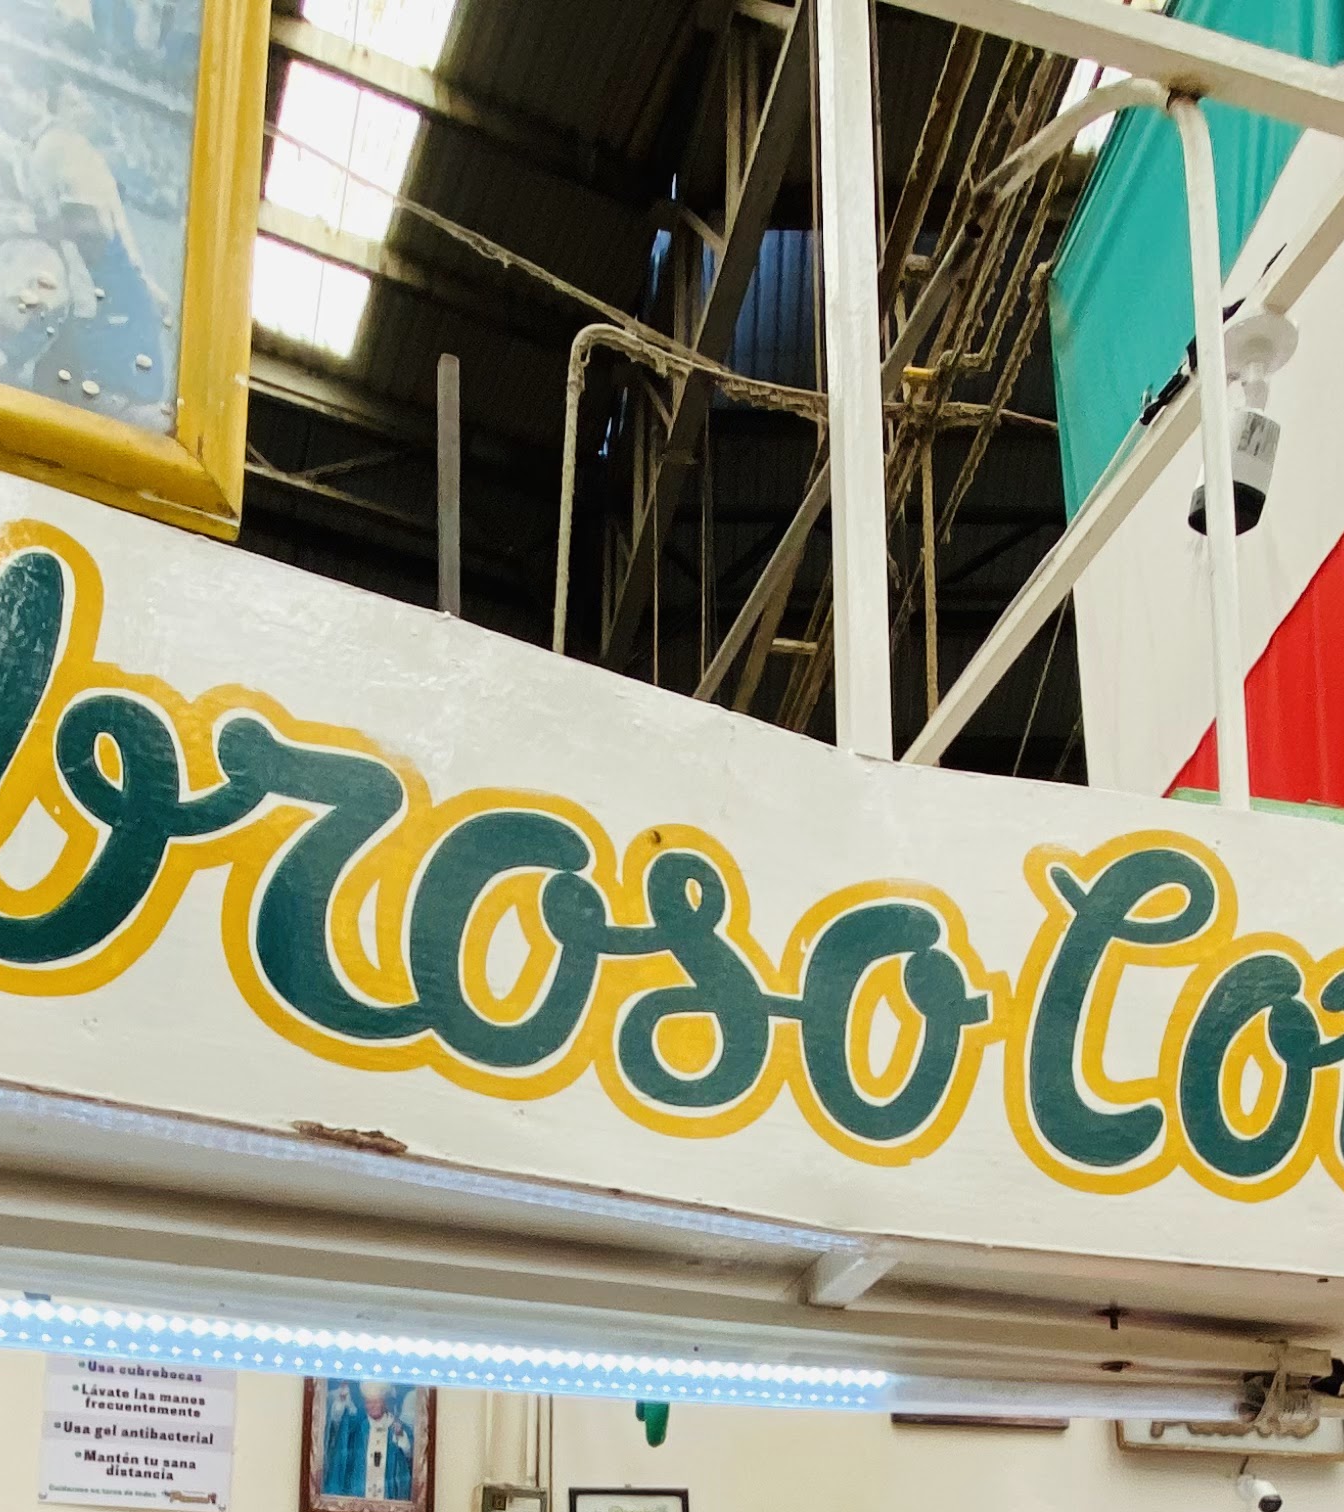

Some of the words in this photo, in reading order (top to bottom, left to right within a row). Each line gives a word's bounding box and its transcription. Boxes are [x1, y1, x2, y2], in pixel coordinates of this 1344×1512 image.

[87, 1360, 115, 1374] Usa
[82, 1384, 130, 1399] Lávate
[134, 1388, 155, 1401] las
[63, 1421, 91, 1435] Usa
[94, 1424, 117, 1440] gel
[121, 1428, 214, 1445] antibacterial
[144, 1455, 159, 1467] tu
[163, 1459, 197, 1470] sana
[106, 1465, 174, 1481] distancia
